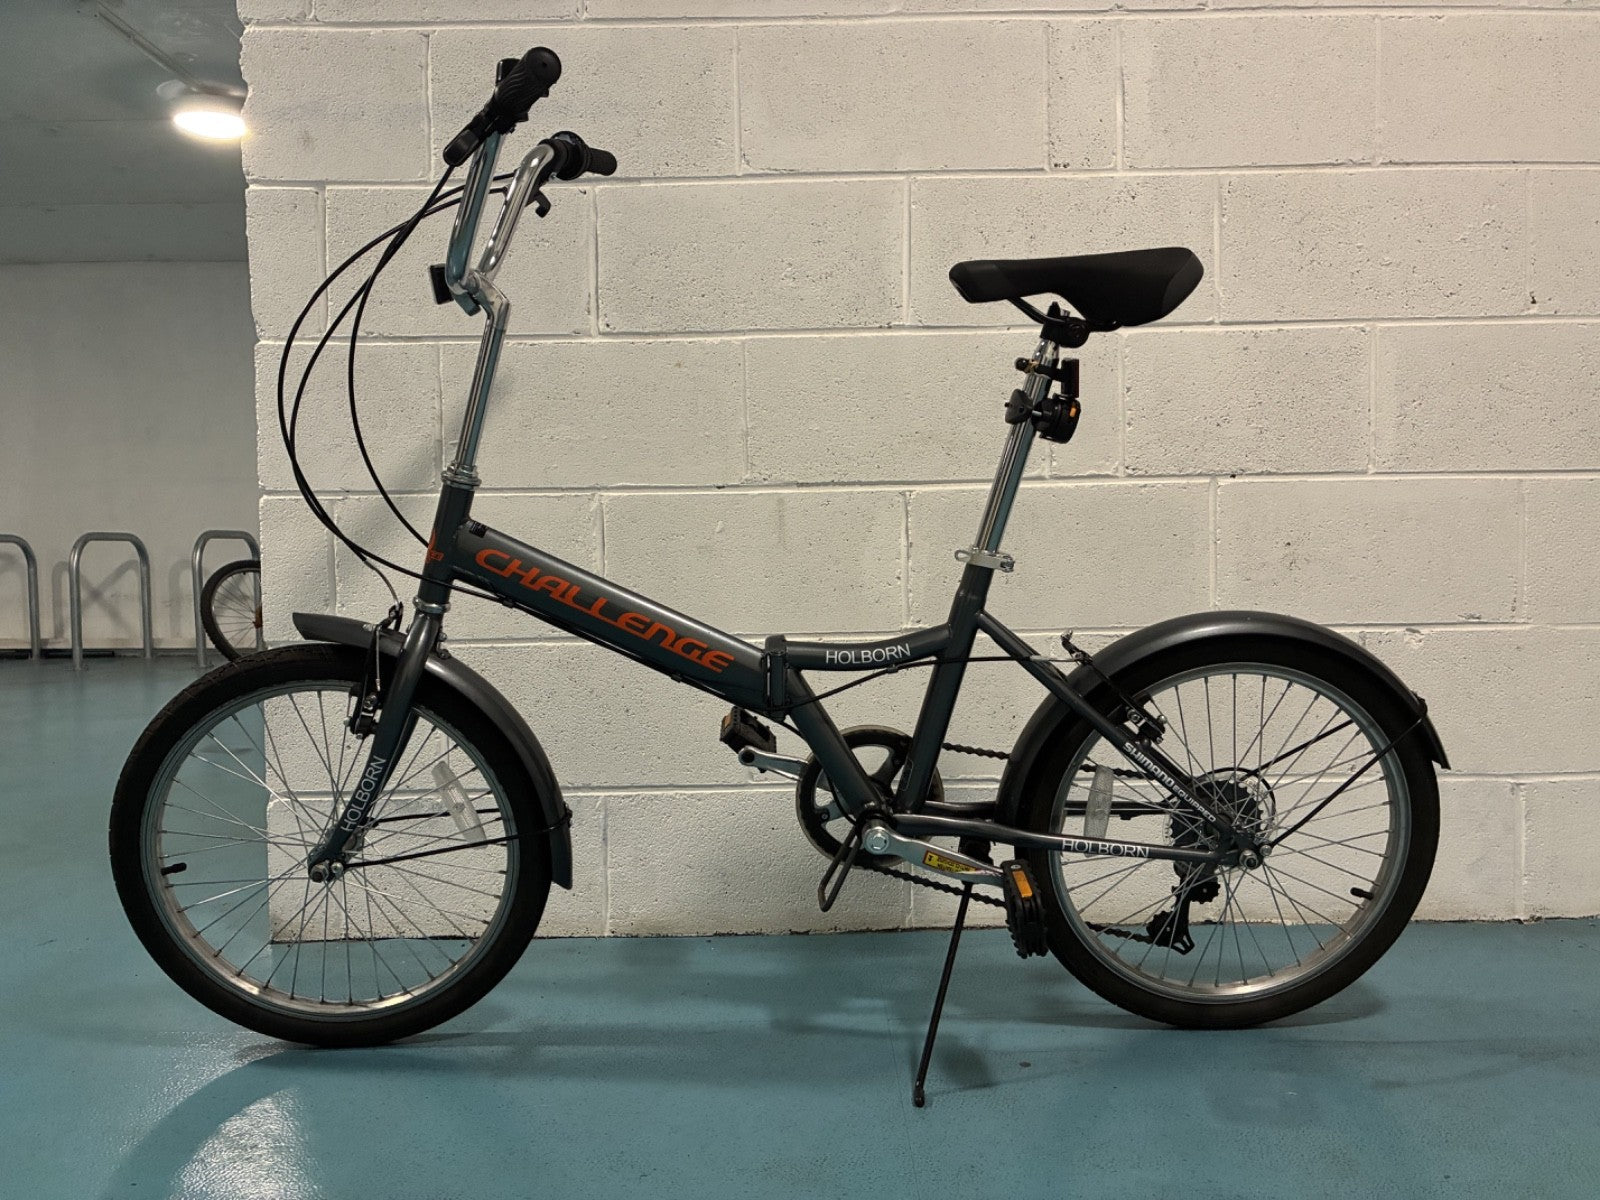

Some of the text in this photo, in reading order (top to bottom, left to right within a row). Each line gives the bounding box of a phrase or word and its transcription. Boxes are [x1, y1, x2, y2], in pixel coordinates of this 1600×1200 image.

[474, 548, 735, 673] CHALLENGE
[825, 642, 911, 665] HOLBORN
[340, 755, 387, 832] HOLBORN
[1122, 741, 1217, 822] SHIMANO EQUIPPED
[1061, 839, 1150, 858] HOLBORN
